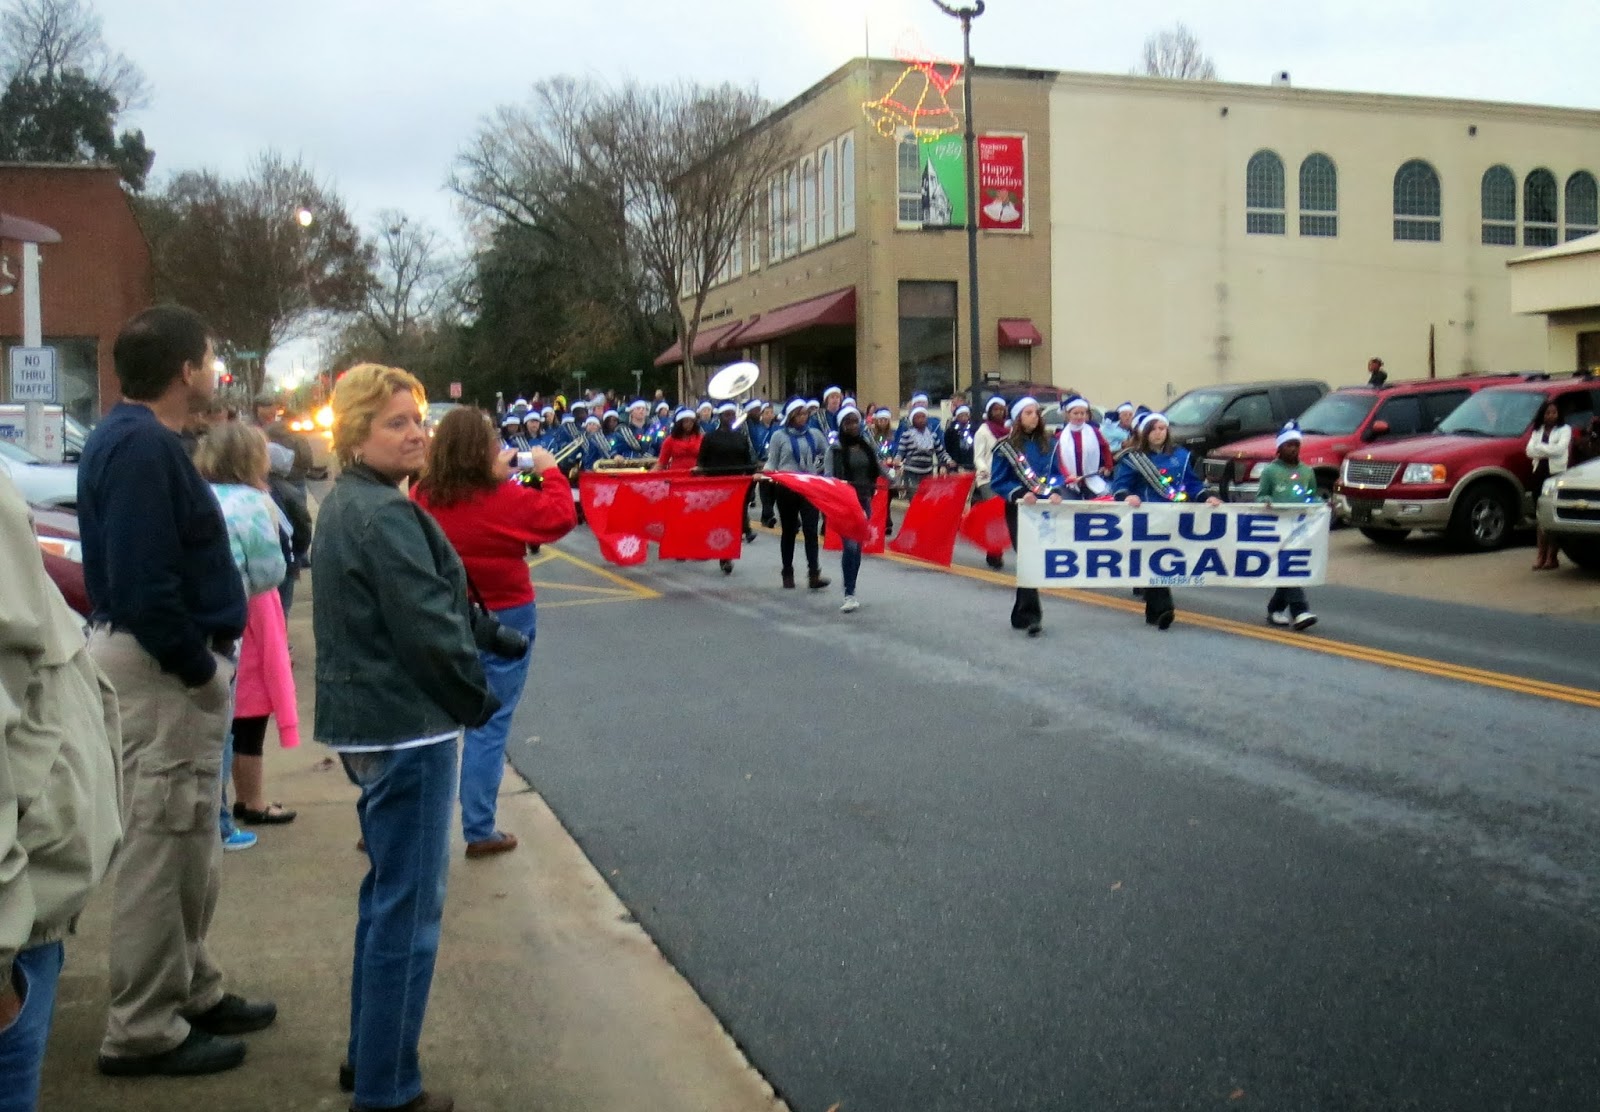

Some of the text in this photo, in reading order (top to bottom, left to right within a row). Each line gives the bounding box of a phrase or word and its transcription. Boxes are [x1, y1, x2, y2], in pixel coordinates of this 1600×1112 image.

[982, 163, 1014, 177] Happy
[982, 175, 1022, 189] Holidays
[25, 355, 40, 366] NO
[21, 370, 46, 381] THRU
[14, 384, 51, 394] TRAFFIC
[1073, 512, 1281, 543] BLUE
[1044, 548, 1313, 579] BRIGADE
